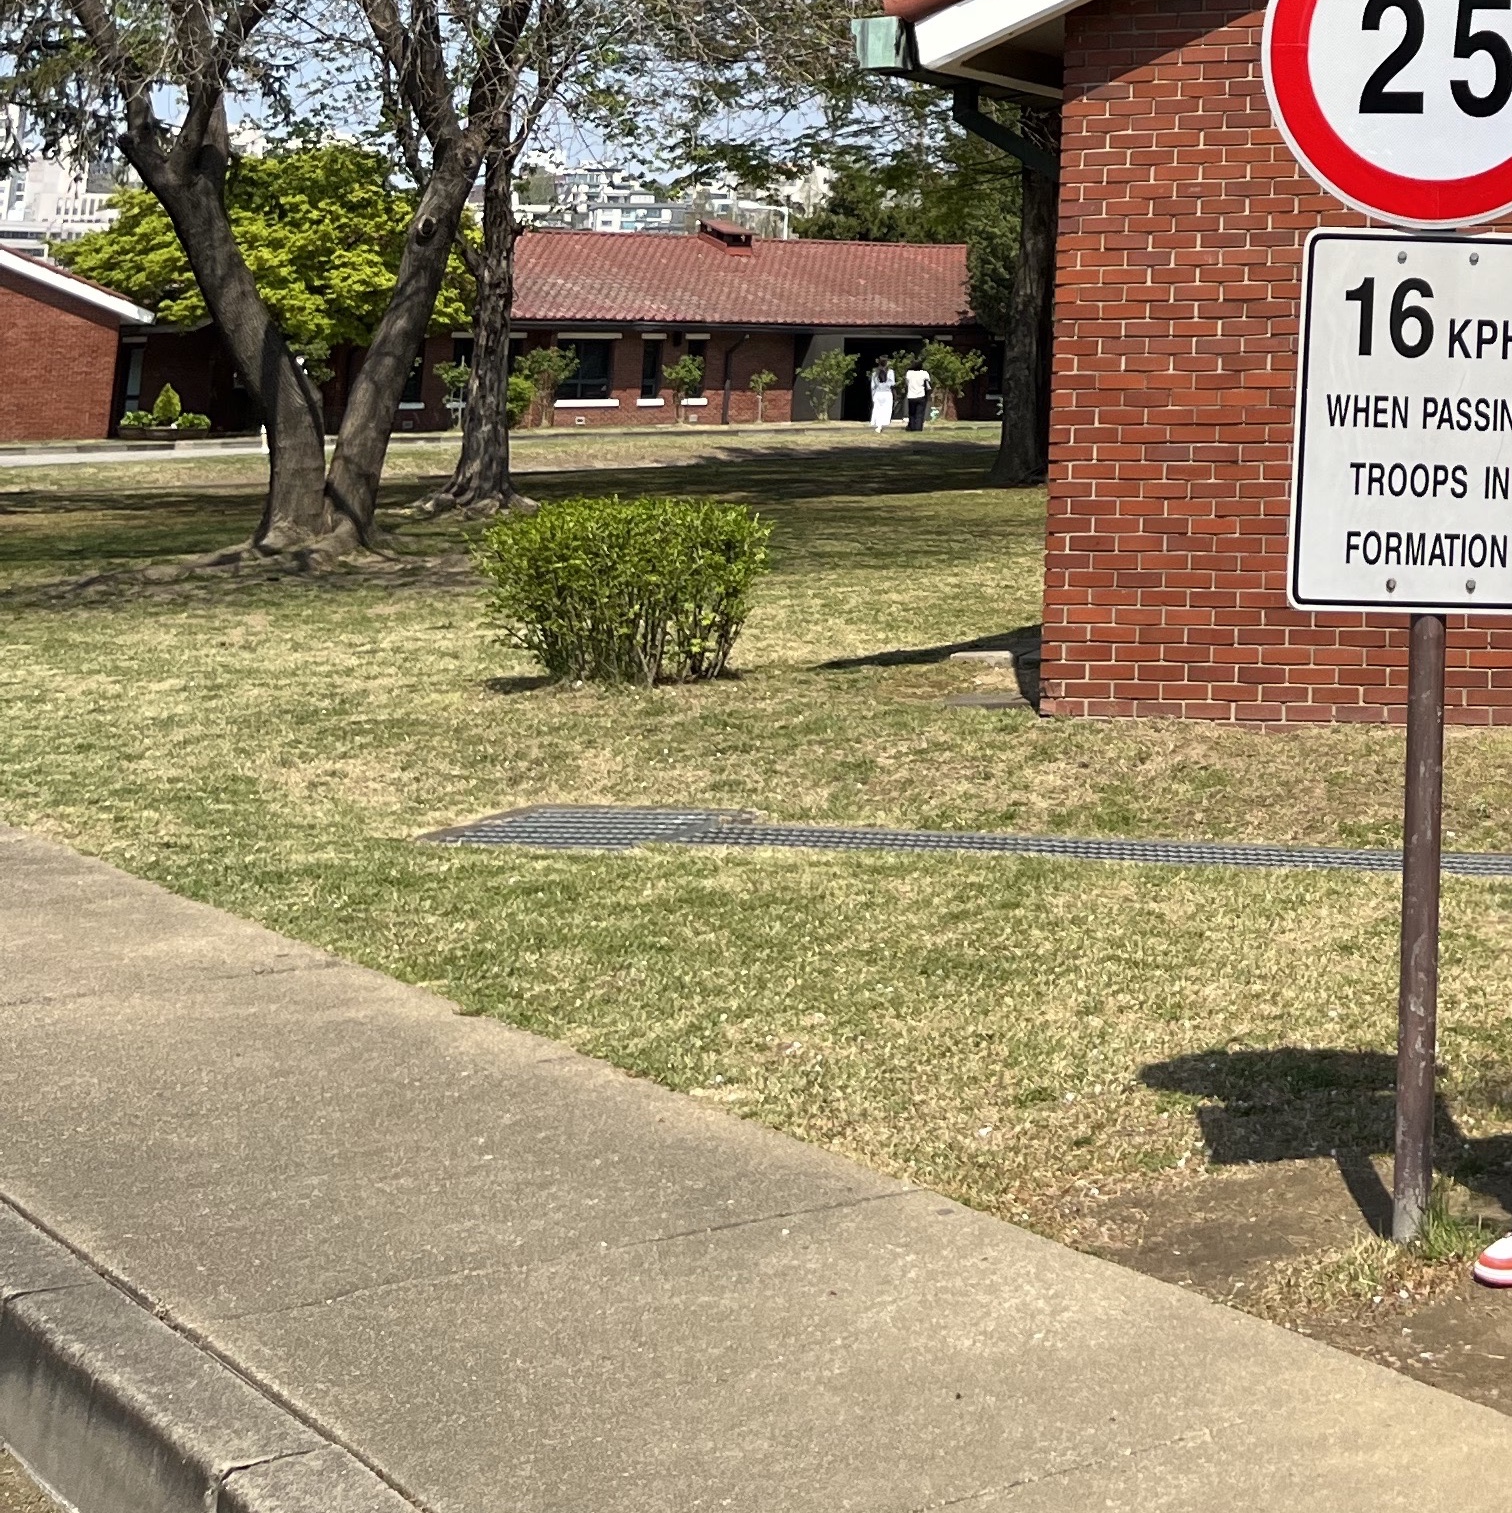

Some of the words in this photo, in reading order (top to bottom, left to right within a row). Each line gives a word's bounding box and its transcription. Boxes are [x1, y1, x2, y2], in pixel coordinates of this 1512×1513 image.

[1345, 277, 1434, 359] 16
[1326, 393, 1410, 430] WHEN
[1349, 461, 1468, 499] TROOPS
[1484, 465, 1511, 500] IN
[1345, 530, 1508, 568] FORMATION
